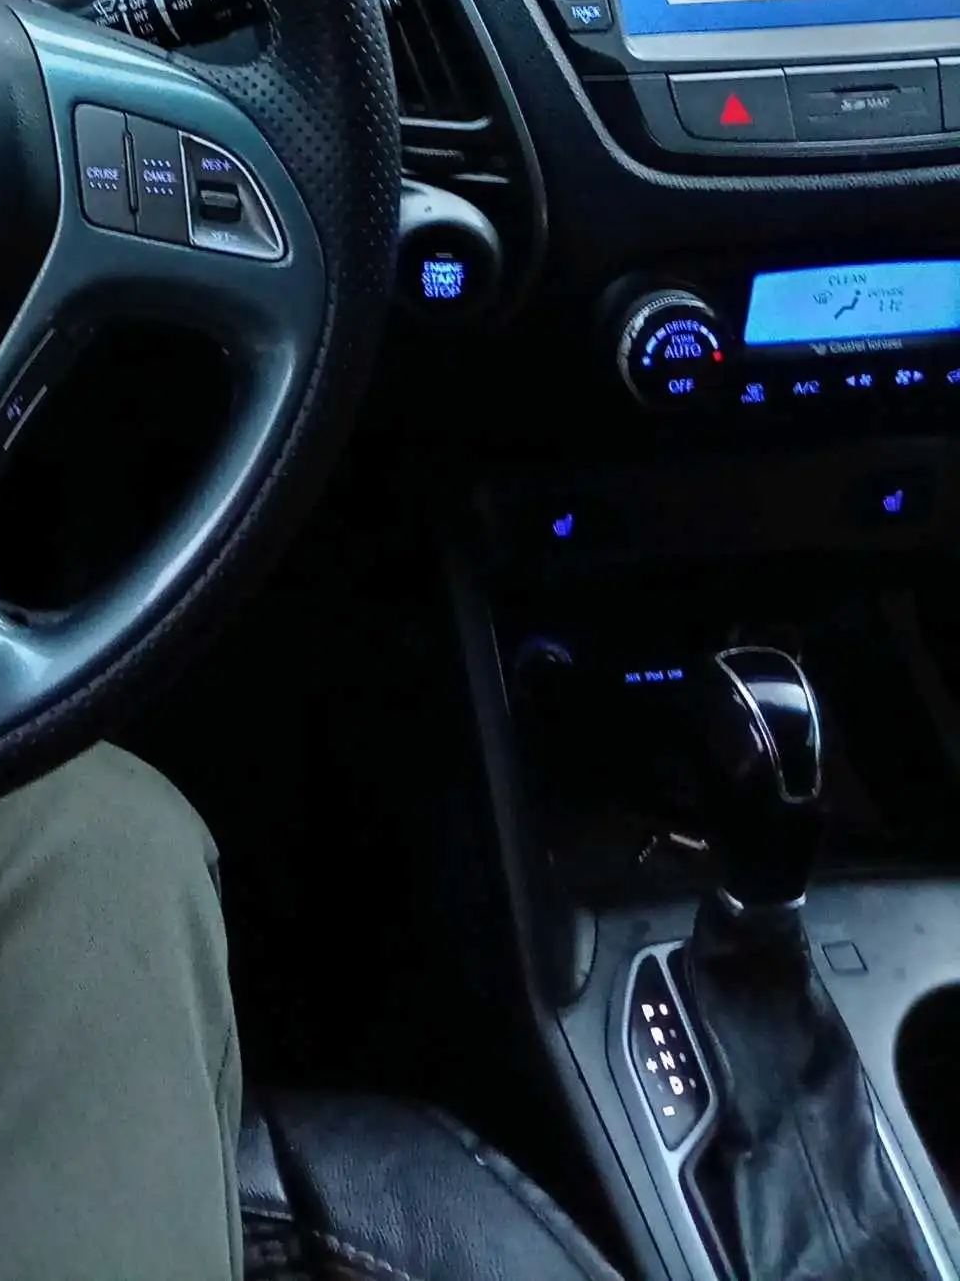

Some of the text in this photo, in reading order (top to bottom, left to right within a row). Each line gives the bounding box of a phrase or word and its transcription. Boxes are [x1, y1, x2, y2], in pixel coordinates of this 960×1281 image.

[423, 261, 464, 273] ENGINE
[421, 271, 465, 286] START
[423, 284, 462, 298] STOP
[664, 342, 702, 359] AUTO
[668, 378, 695, 394] OFF
[641, 1003, 655, 1023] P
[650, 1026, 667, 1046] R
[659, 1049, 676, 1071] N
[668, 1075, 685, 1096] D
